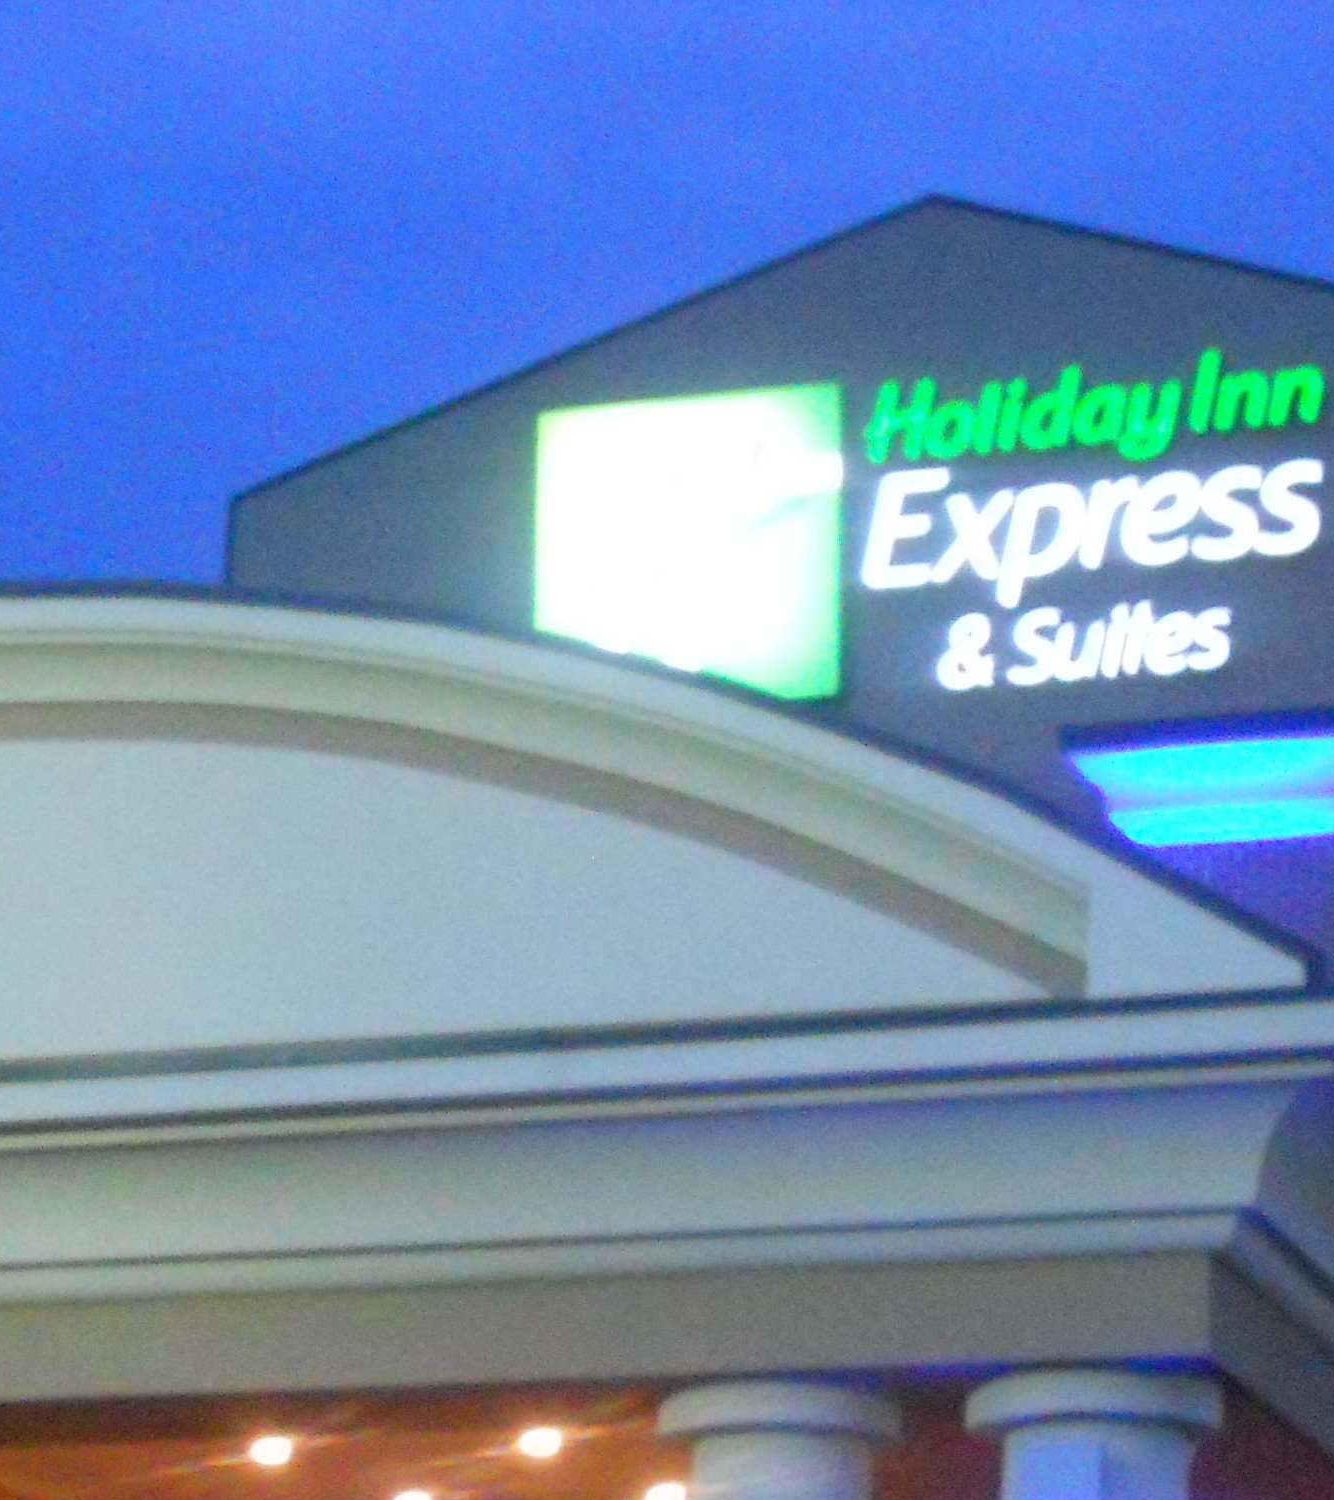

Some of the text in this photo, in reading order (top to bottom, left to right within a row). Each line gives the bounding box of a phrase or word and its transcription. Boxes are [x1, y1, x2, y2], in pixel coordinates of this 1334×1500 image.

[866, 347, 1324, 462] Holiday Inn
[861, 458, 1324, 608] Express
[935, 601, 1233, 691] & Suites
